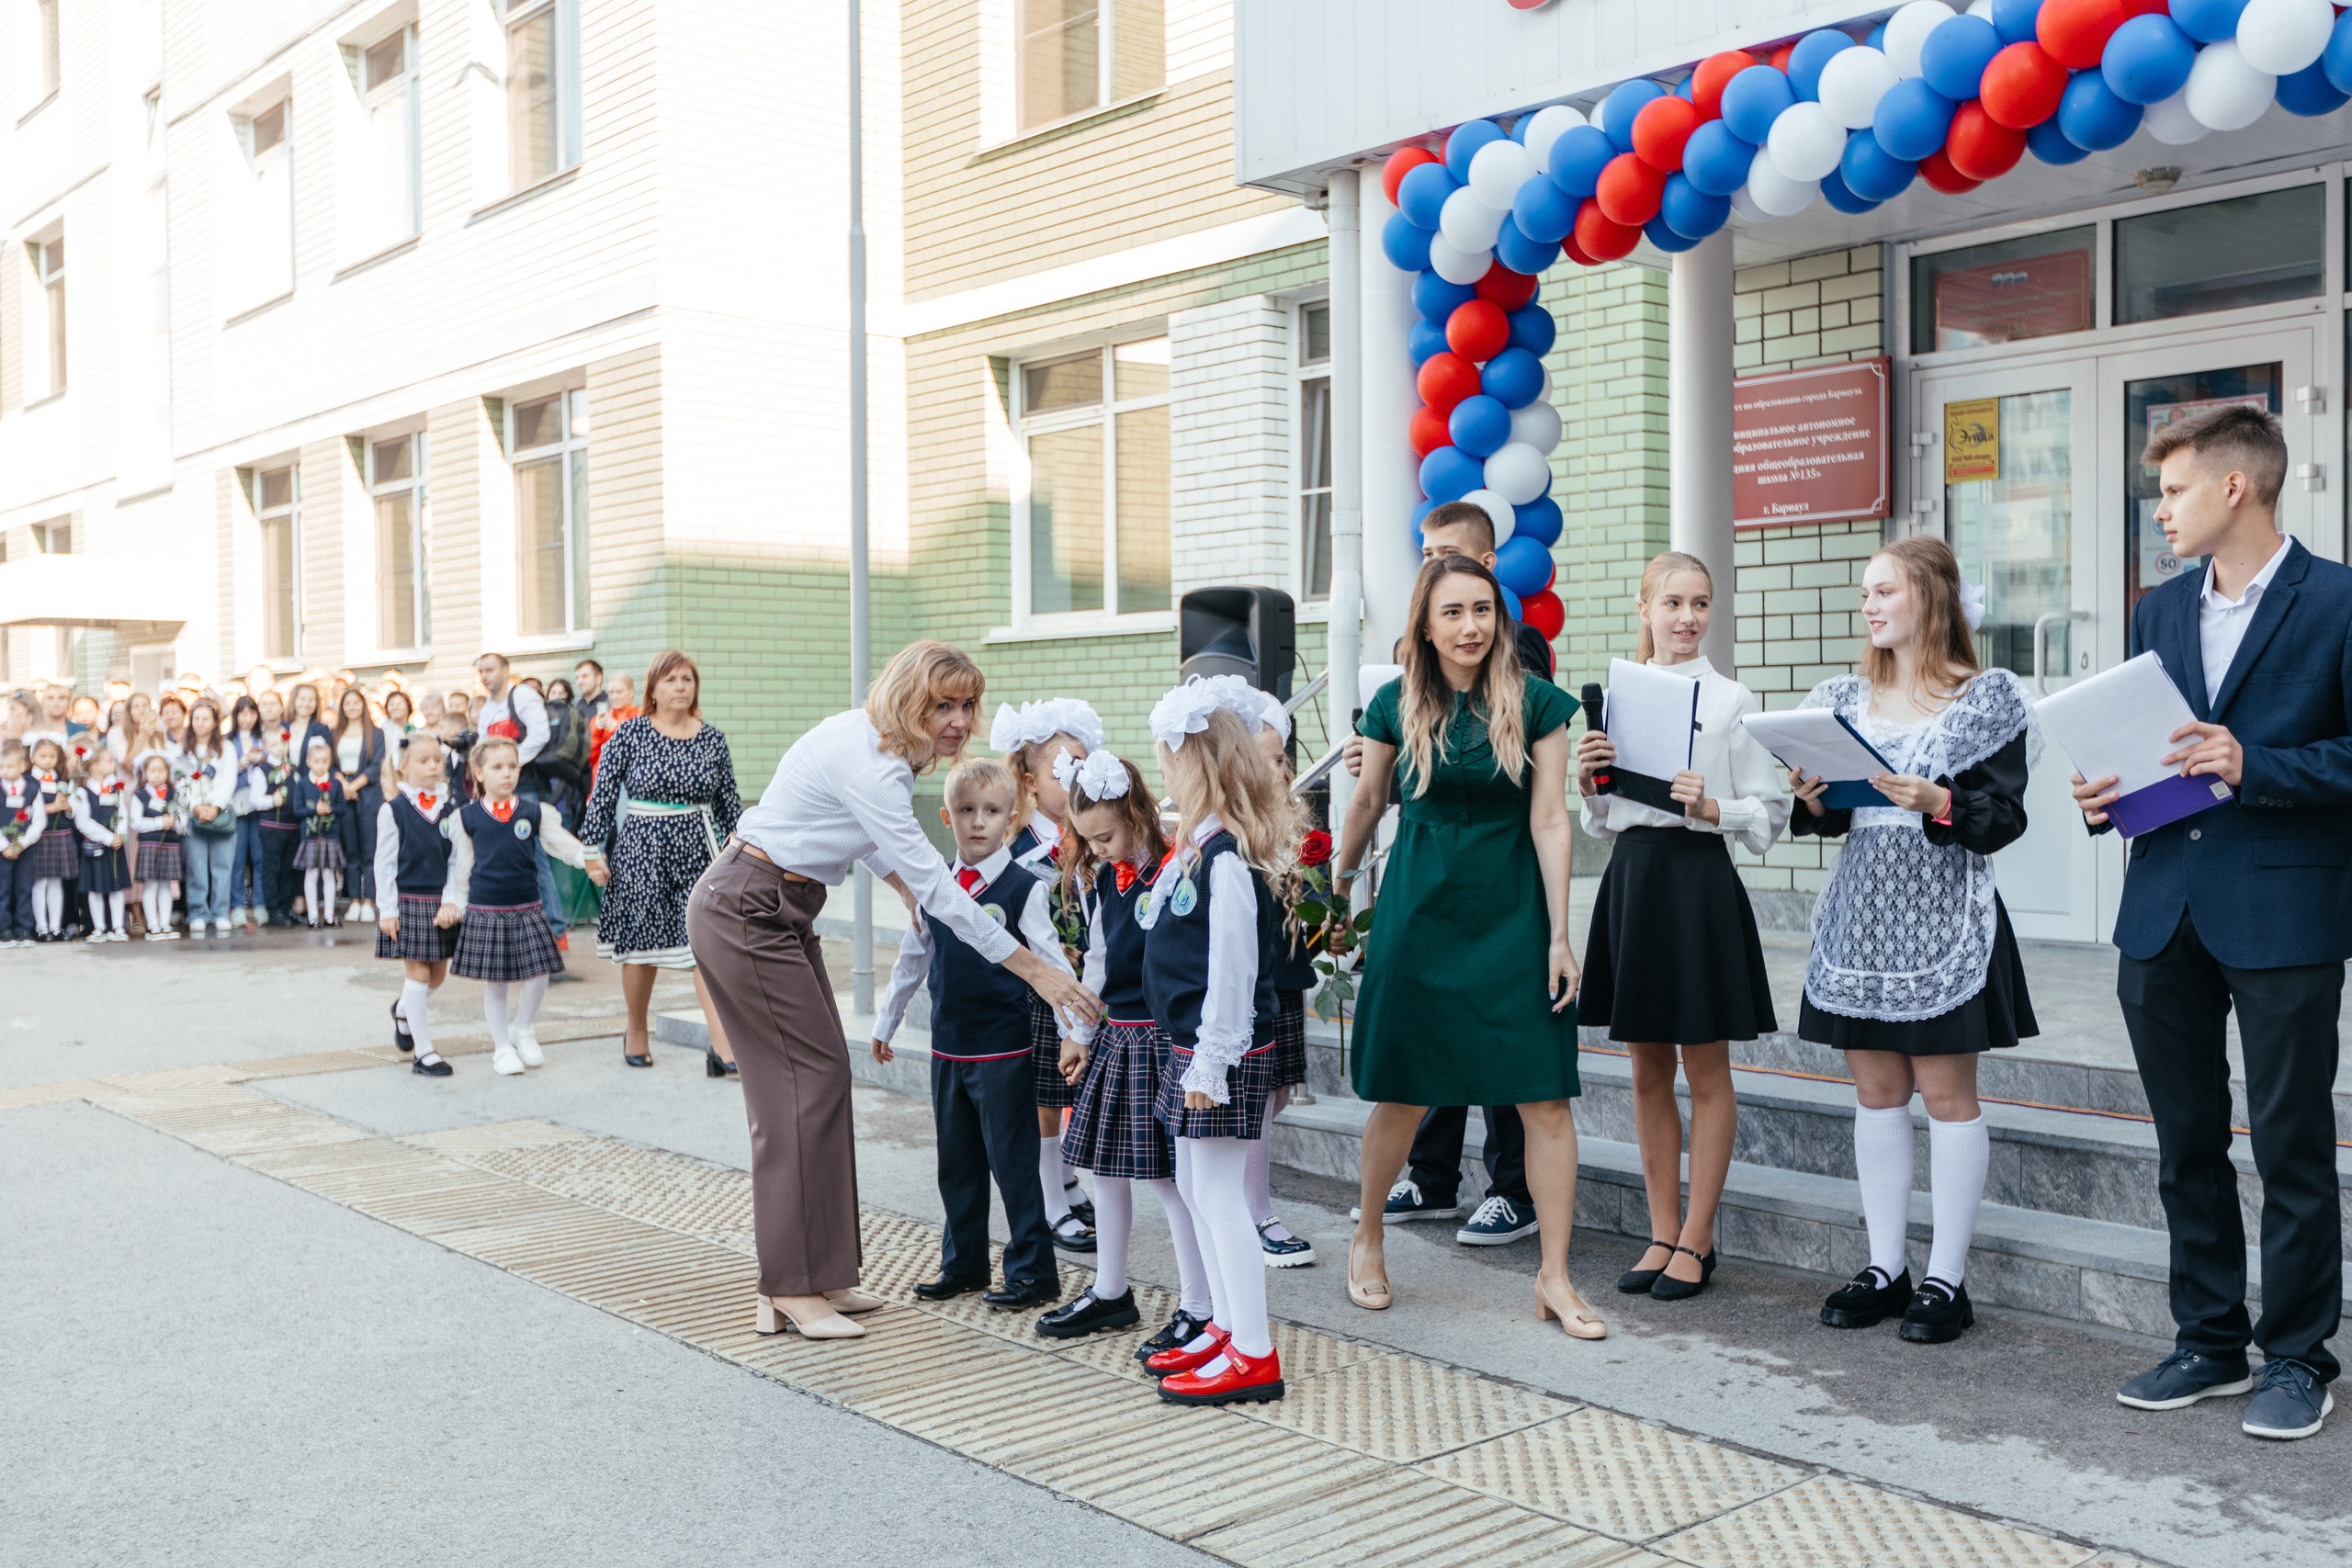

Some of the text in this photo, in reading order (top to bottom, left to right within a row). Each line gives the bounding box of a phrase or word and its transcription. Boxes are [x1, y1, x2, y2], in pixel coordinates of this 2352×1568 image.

[1753, 396, 1802, 411] образованию
[1802, 391, 1827, 404] города
[1827, 387, 1862, 400] Барнаула
[1798, 416, 1856, 432] автономное
[1811, 428, 1871, 447] учреждение
[1757, 450, 1865, 471] общеобразовательная
[1757, 468, 1822, 485] школа №135»
[1771, 502, 1809, 515] Барнаул
[2160, 558, 2177, 570] 50
